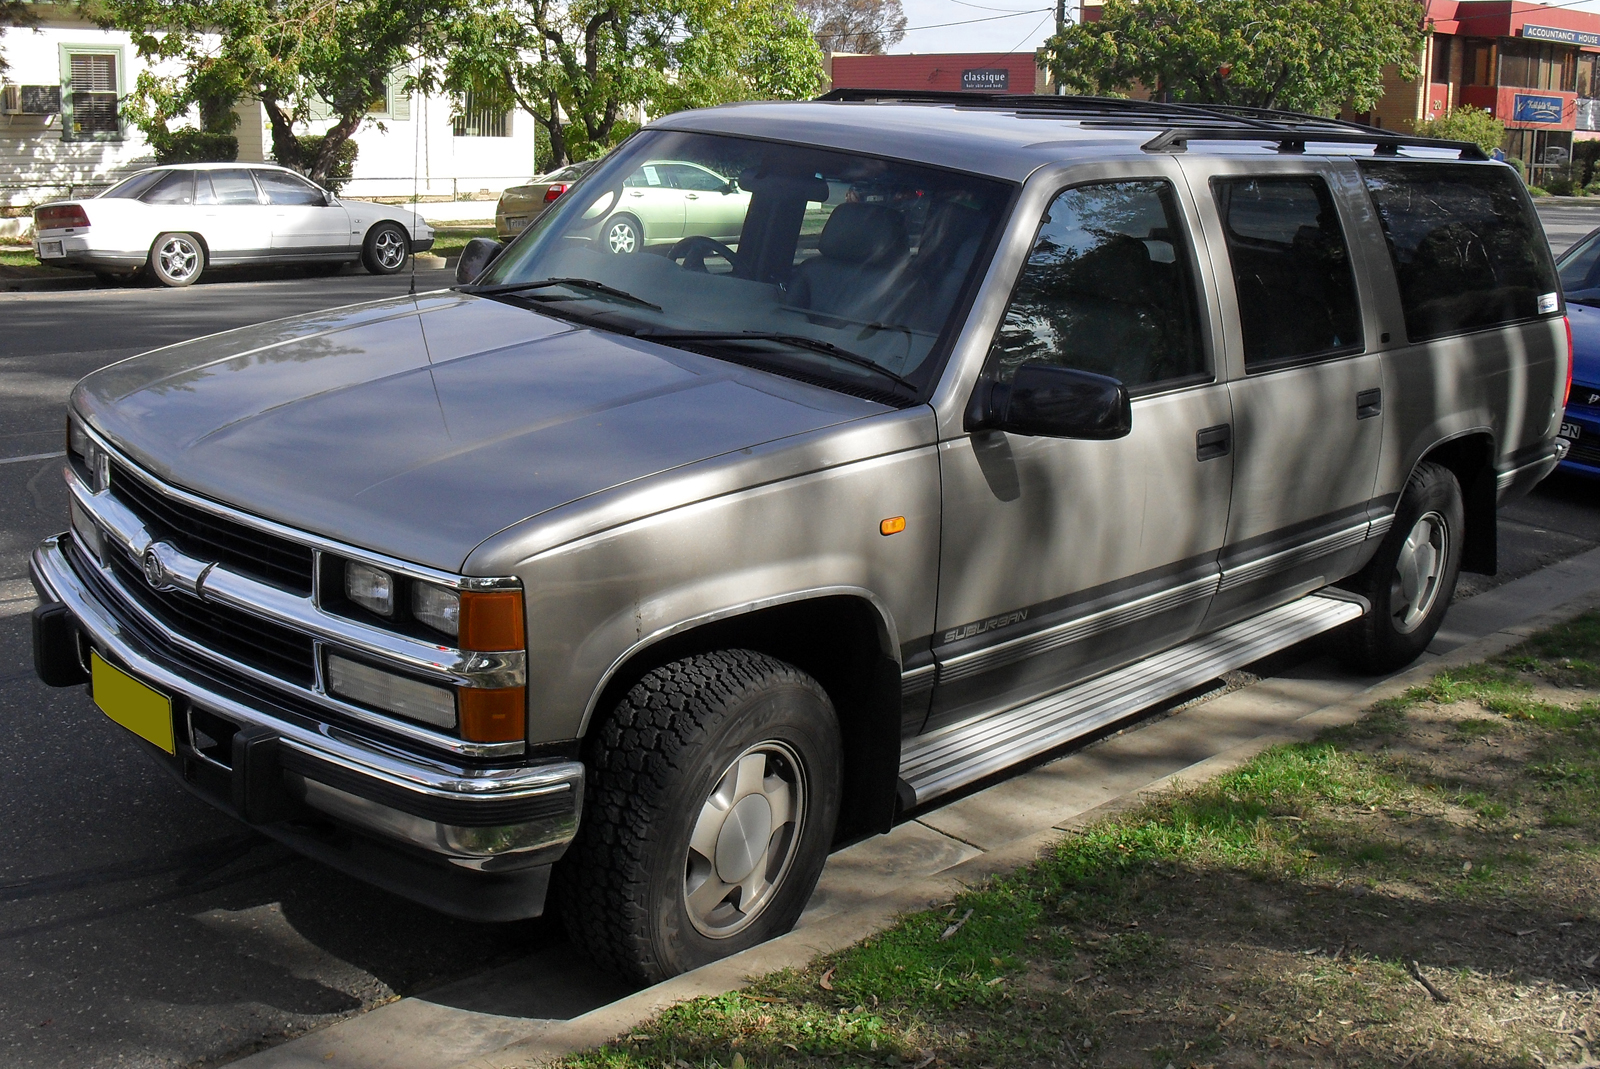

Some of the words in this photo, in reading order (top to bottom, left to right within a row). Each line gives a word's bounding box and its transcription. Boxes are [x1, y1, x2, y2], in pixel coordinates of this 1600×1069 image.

[1527, 27, 1576, 41] ACCOUNTANCY
[1578, 34, 1598, 44] HOUSE
[963, 71, 1005, 84] classique
[1433, 99, 1442, 111] 20
[943, 609, 1029, 644] SUBURBAN
